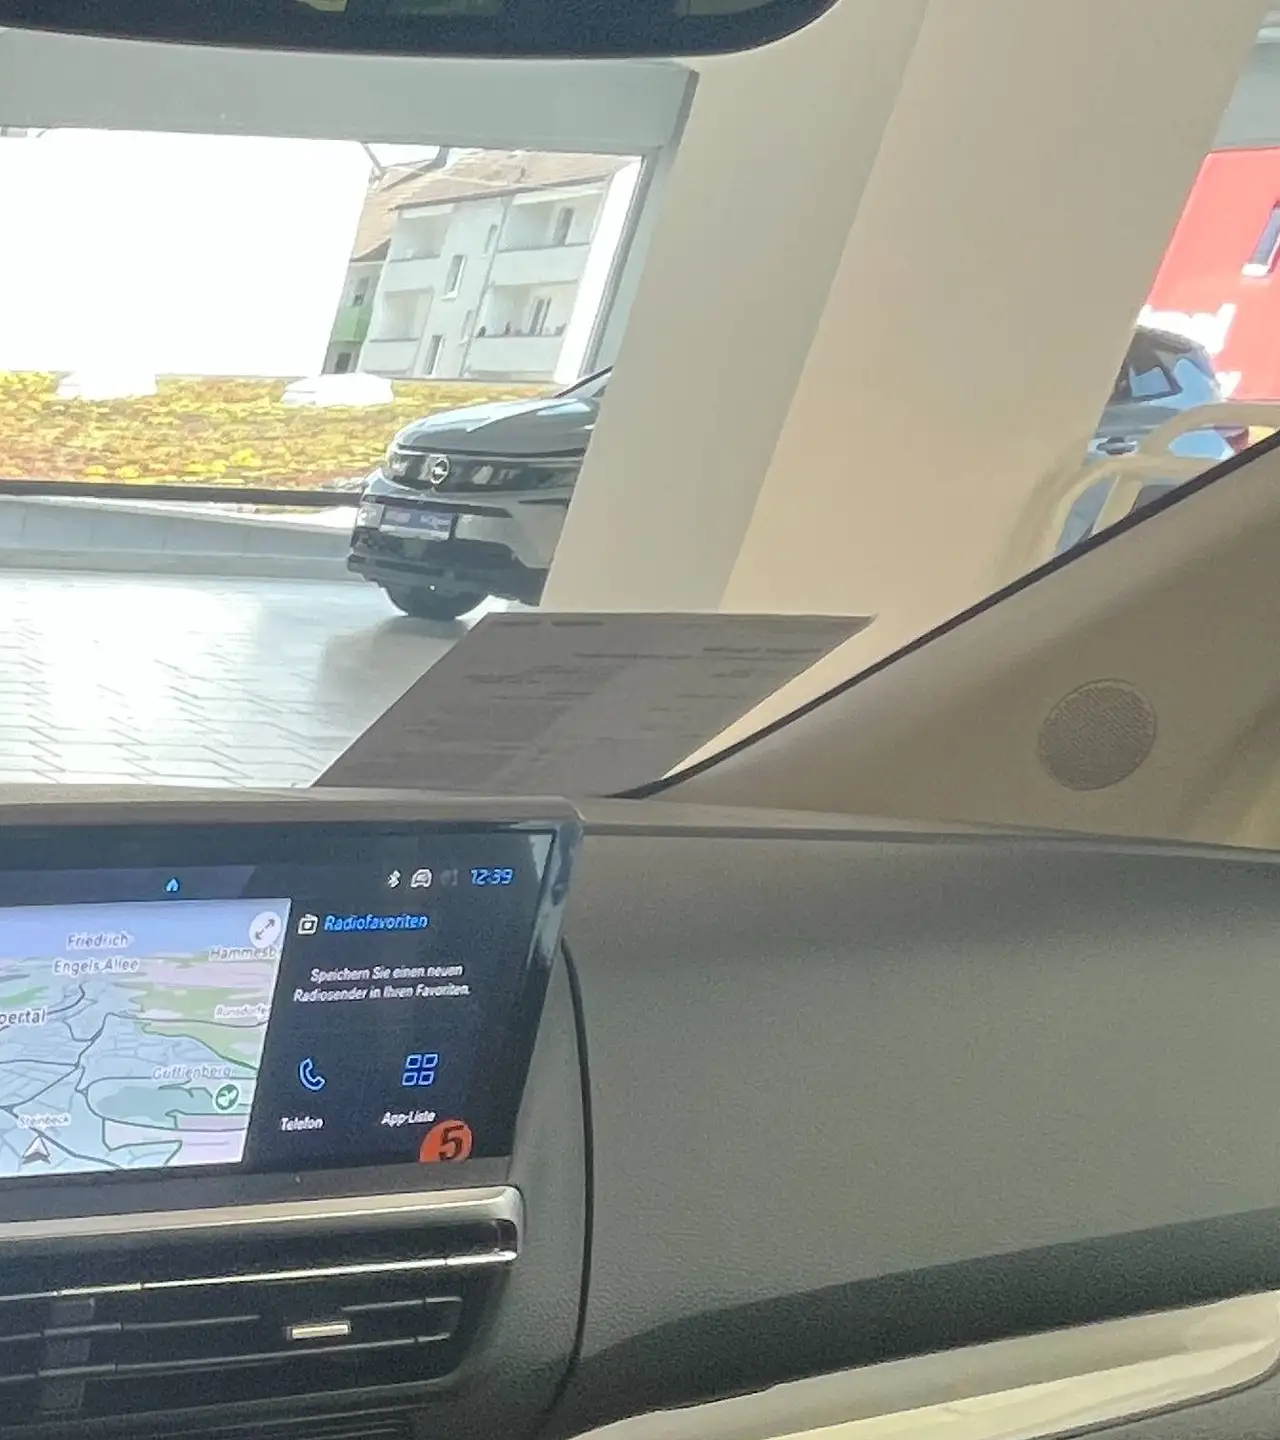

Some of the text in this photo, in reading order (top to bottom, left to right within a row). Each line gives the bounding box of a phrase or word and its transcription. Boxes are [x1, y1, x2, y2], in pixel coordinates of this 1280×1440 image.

[324, 914, 428, 931] Radiofavoriten
[310, 965, 463, 983] Speichern Sie einen neuen
[293, 989, 368, 1001] Radiosender
[369, 987, 381, 998] in
[383, 986, 413, 998] Ihren
[281, 1117, 323, 1131] Telefon
